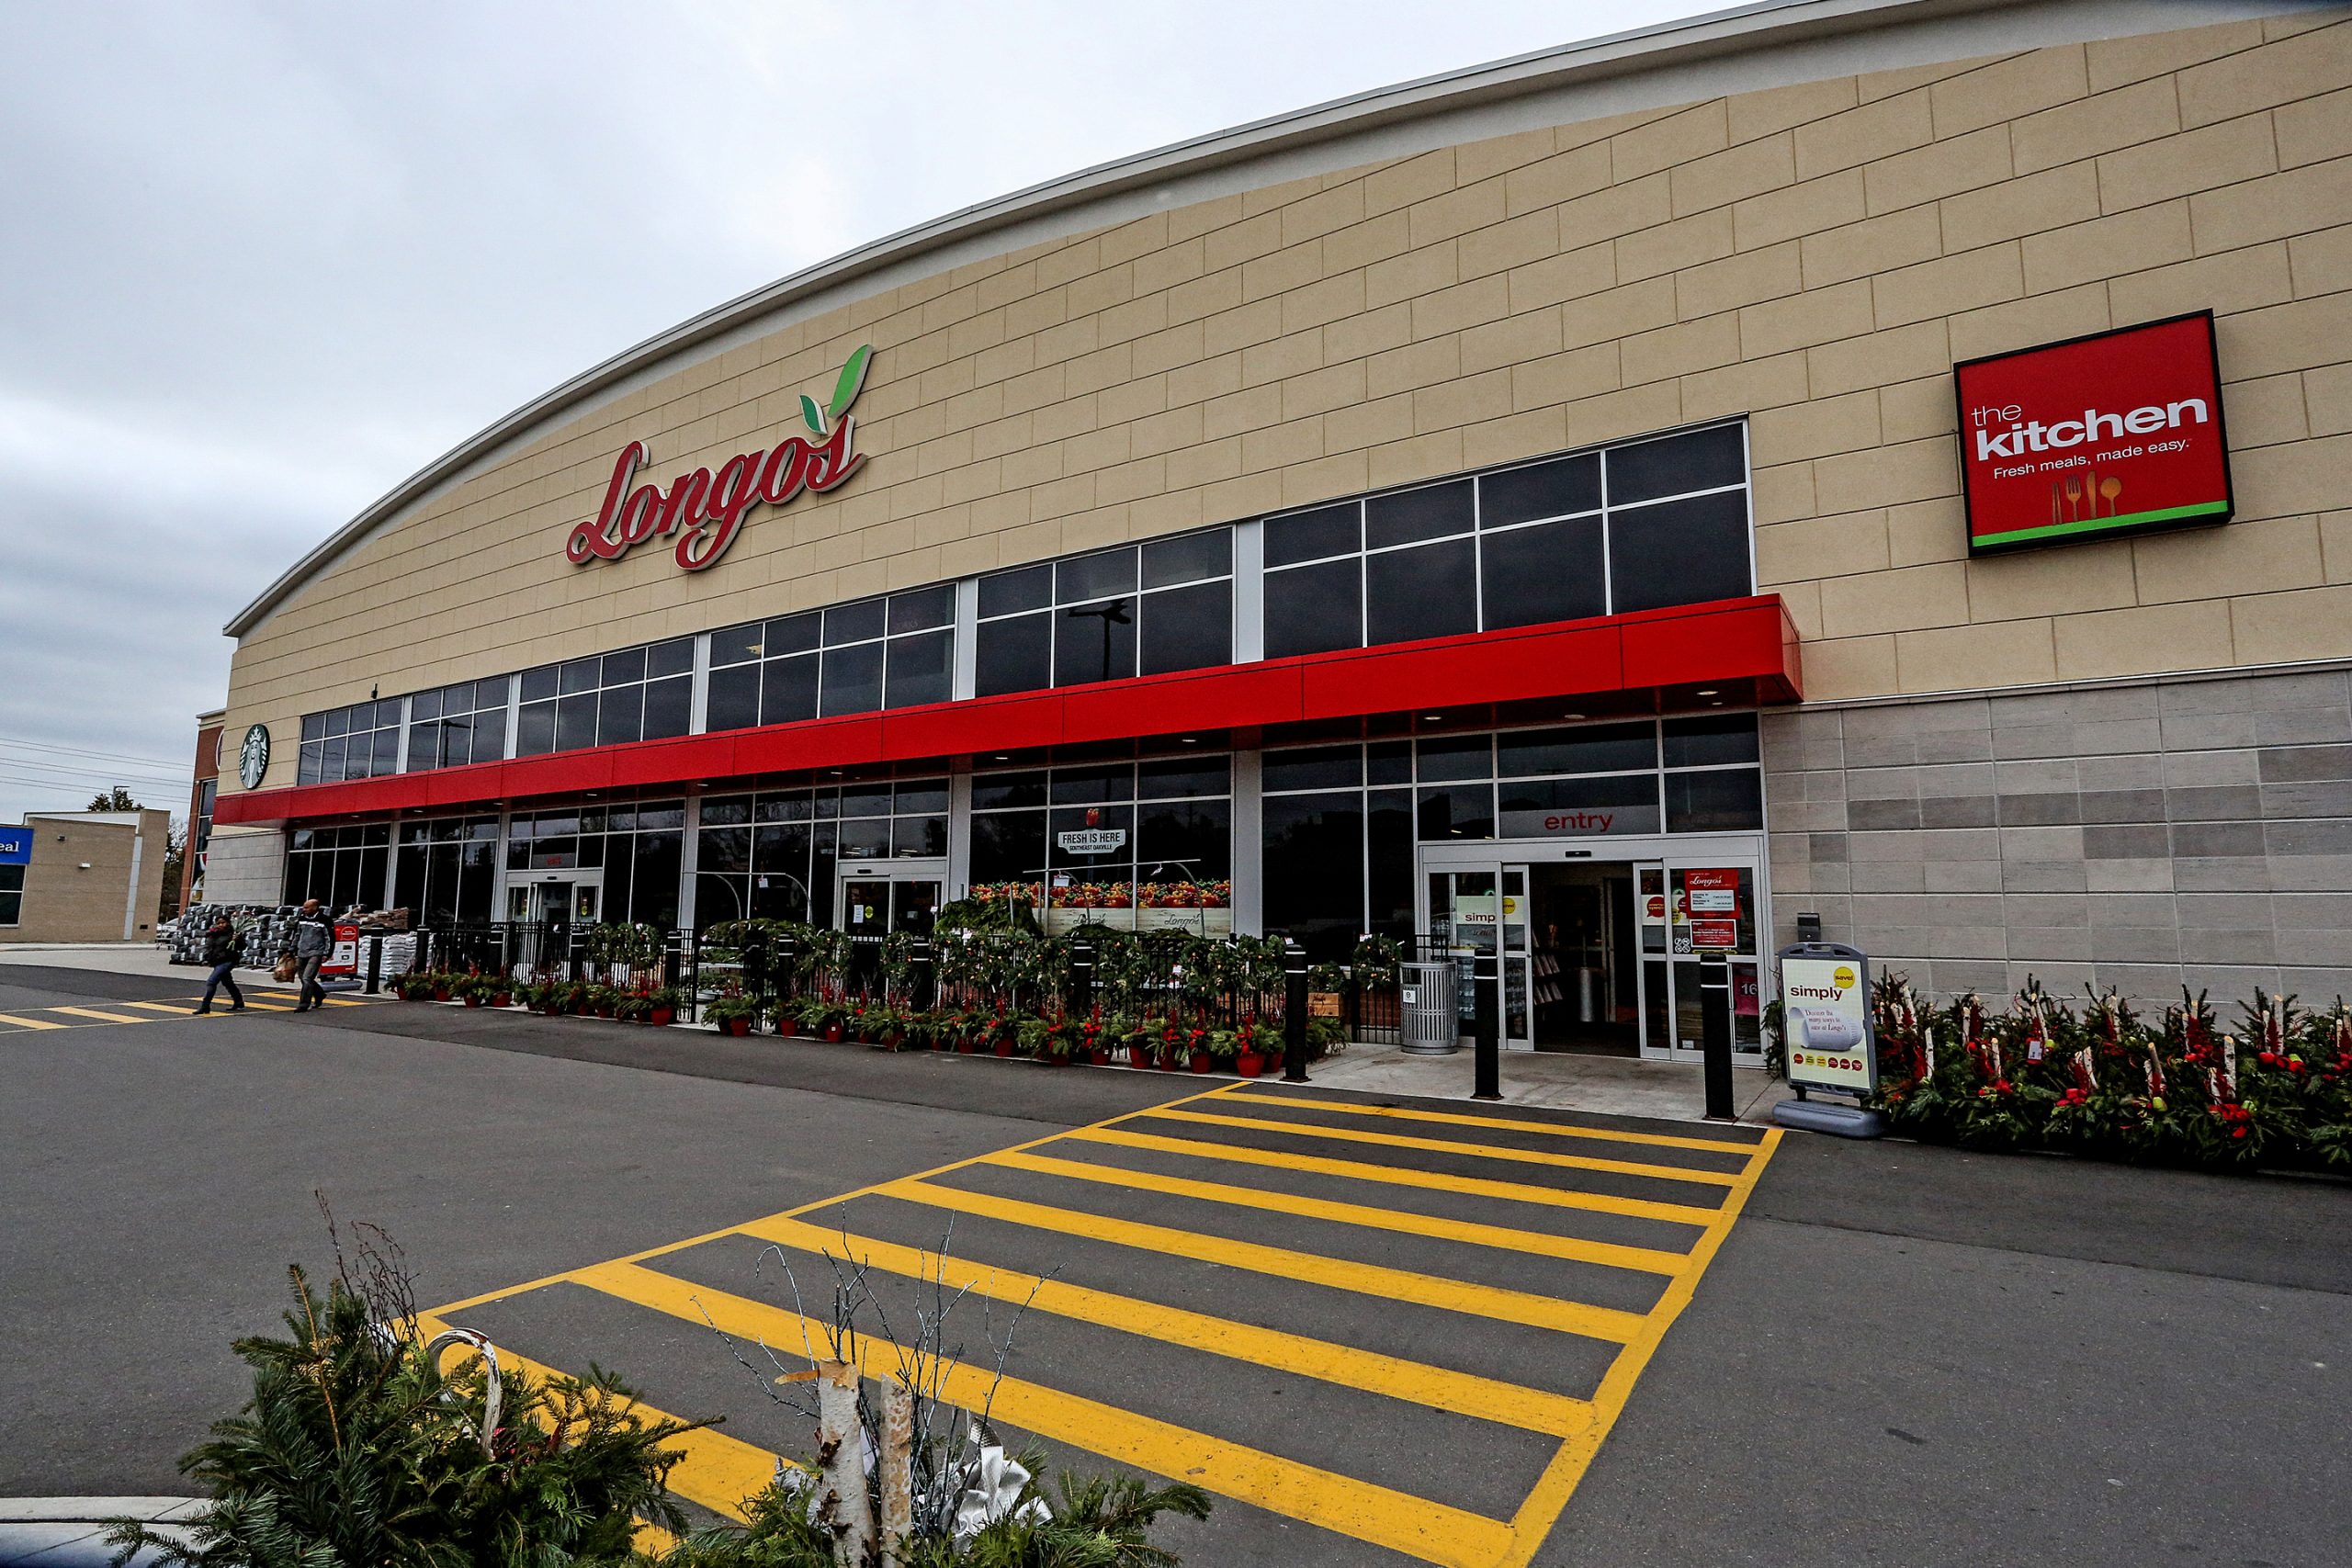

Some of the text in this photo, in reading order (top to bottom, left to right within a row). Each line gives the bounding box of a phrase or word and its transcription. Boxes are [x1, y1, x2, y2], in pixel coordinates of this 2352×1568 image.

[1972, 404, 2022, 427] the
[1976, 398, 2209, 461] kitchen
[1994, 438, 2189, 479] Fresh meals, made easy.
[1544, 812, 1613, 832] entry
[1063, 832, 1121, 844] FRESH IS HERE
[1464, 912, 1507, 924] simp
[1790, 985, 1843, 1001] simply
